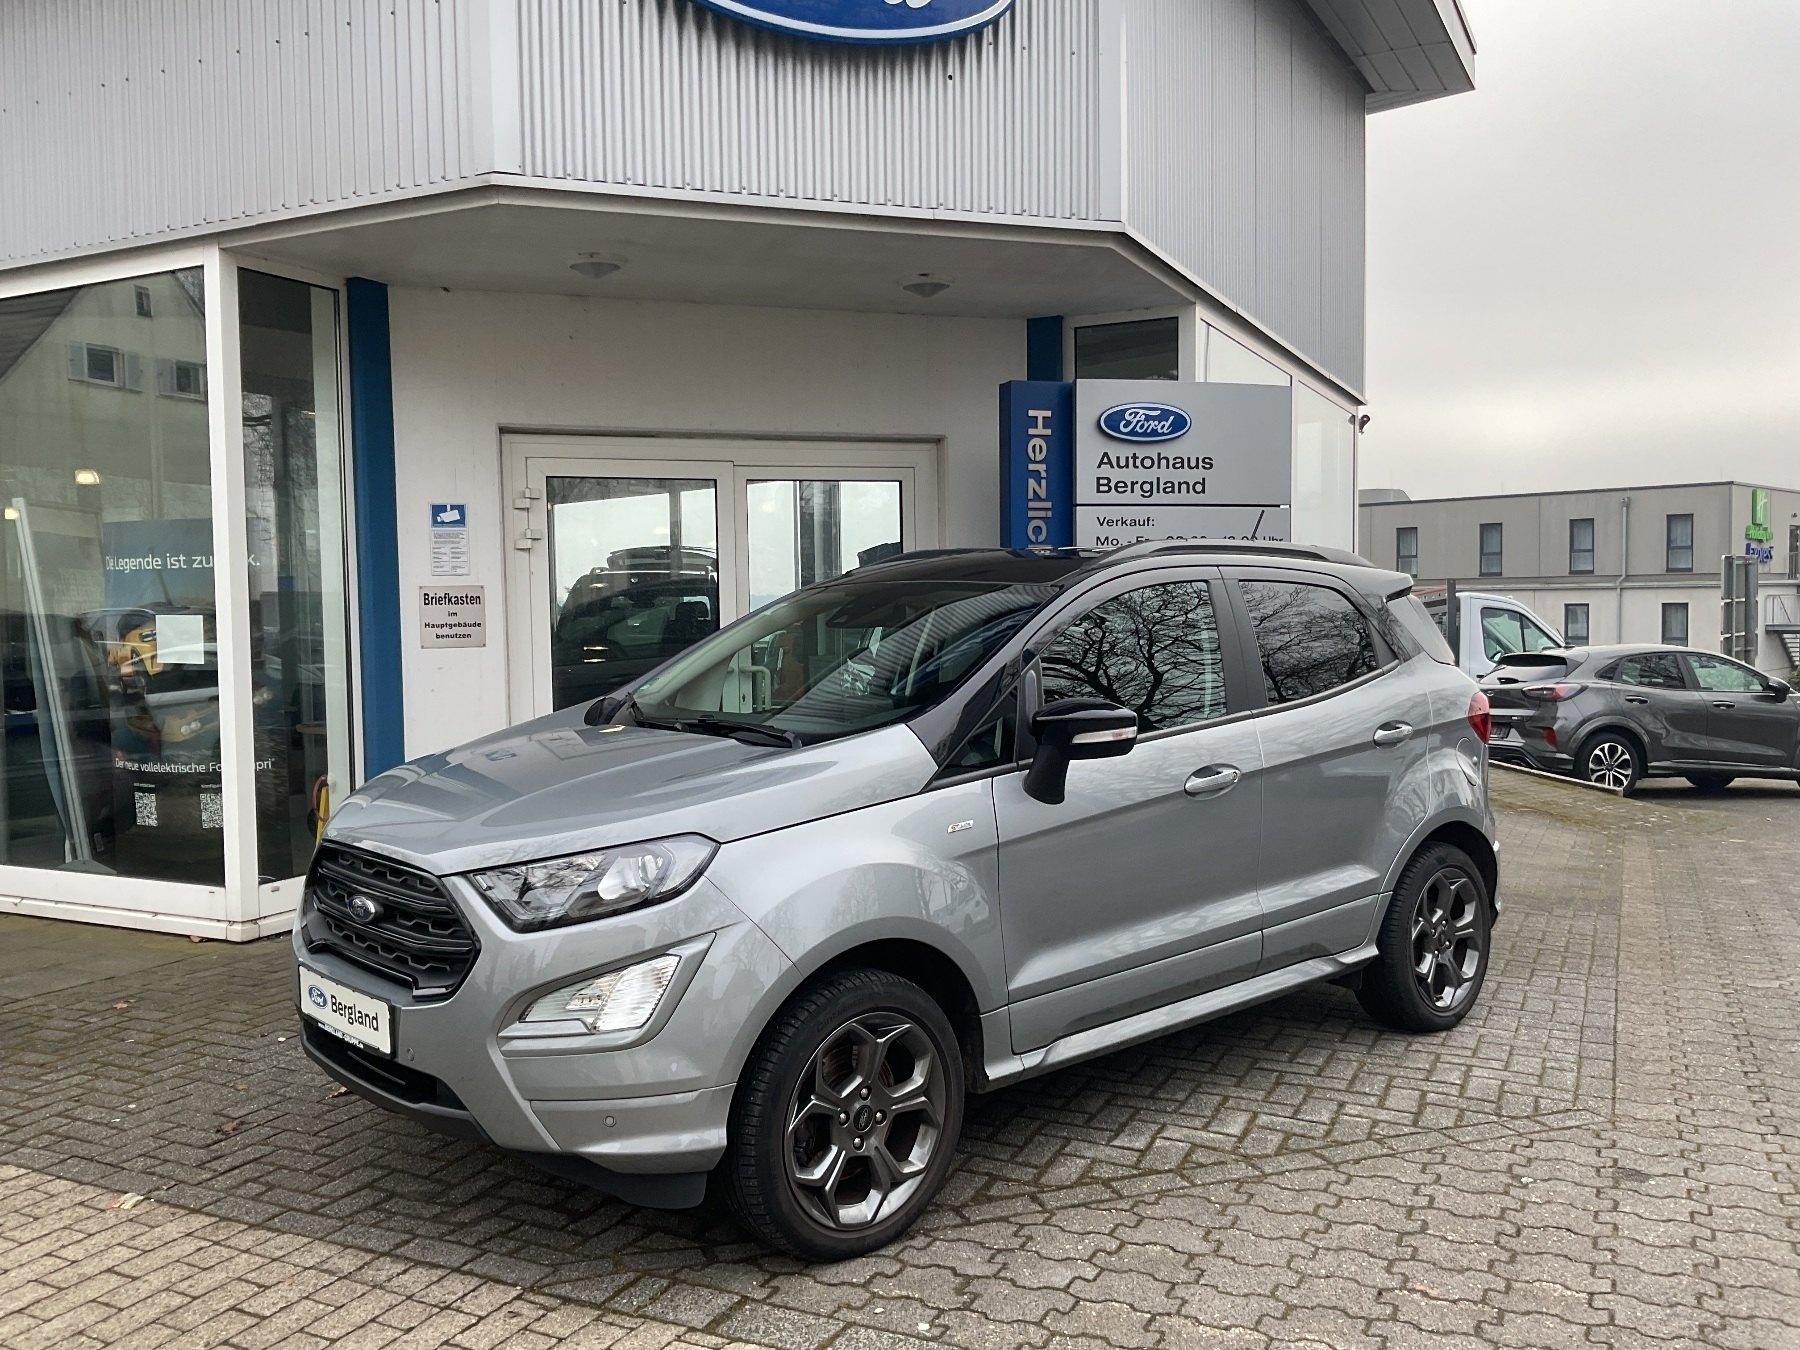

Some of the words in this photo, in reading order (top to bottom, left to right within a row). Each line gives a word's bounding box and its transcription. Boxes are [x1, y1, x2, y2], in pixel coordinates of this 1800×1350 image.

[1120, 407, 1172, 434] Ford
[1096, 452, 1214, 470] Autohaus
[1095, 477, 1206, 499] Bergland
[1096, 516, 1155, 527] Verkauf:
[1095, 536, 1123, 547] Mo.
[115, 554, 162, 573] Legende
[166, 553, 187, 569] ist
[423, 592, 481, 606] Briefkasten
[424, 621, 482, 630] Hauptgebäude
[115, 758, 124, 769] Der
[124, 761, 139, 771] neue
[139, 762, 206, 773] vollelektrische
[330, 994, 379, 1032] Bergland
